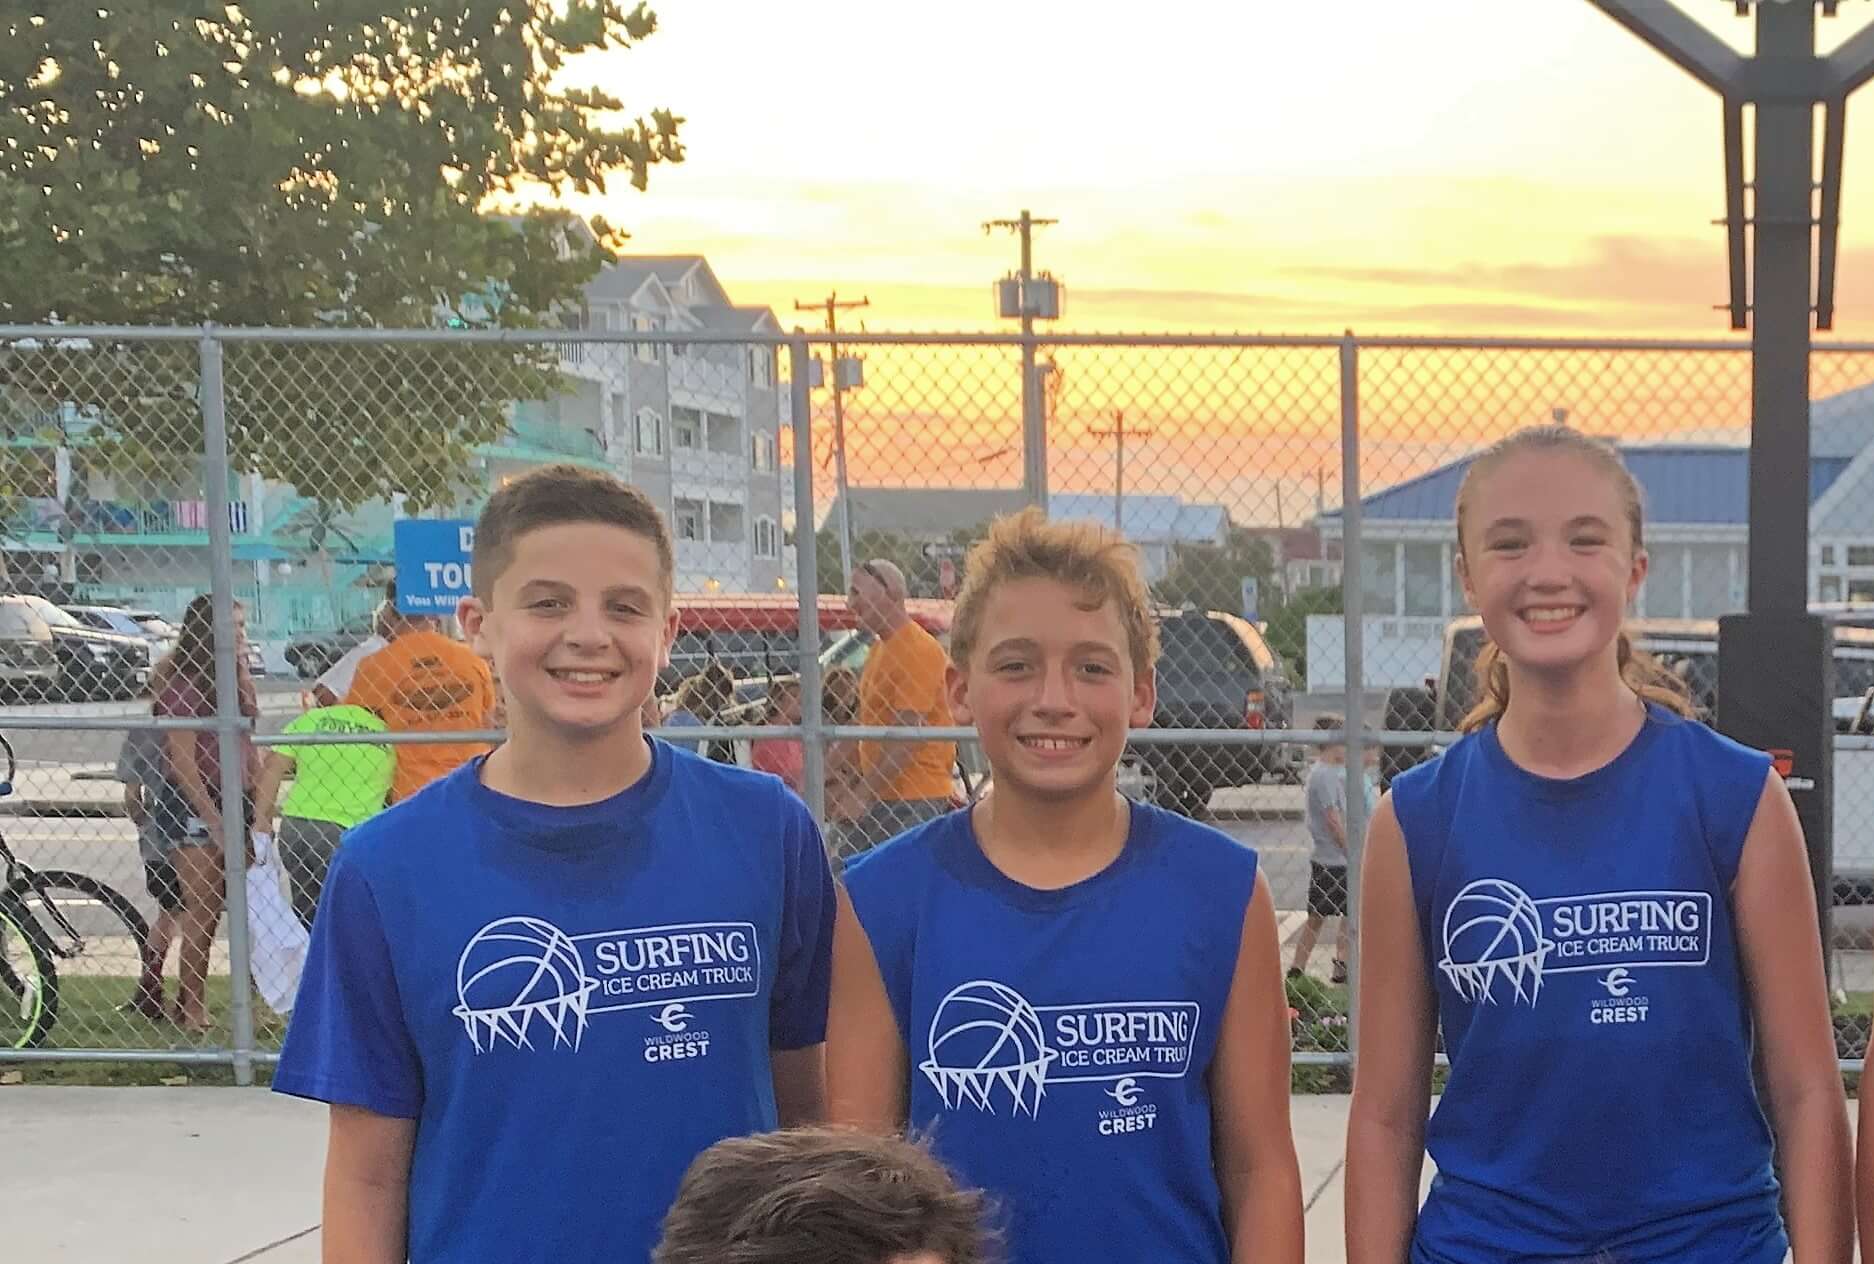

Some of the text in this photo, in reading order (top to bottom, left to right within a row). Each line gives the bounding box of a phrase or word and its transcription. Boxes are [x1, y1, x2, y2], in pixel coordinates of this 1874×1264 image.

[1553, 900, 1699, 938] SURFING
[595, 931, 749, 974] SURFING
[1557, 935, 1699, 957] ICE CREAM TRUCK
[602, 966, 752, 996] ICE CREAM TRUCK
[1591, 996, 1649, 1008] WILDWOOD
[1590, 1006, 1649, 1024] CREST
[643, 1030, 710, 1047] WILDWOOD
[1056, 1010, 1188, 1046] SURFING
[644, 1040, 710, 1062] CREST
[1060, 1049, 1090, 1067] ICE
[1093, 1046, 1150, 1066] CREAM
[1098, 1103, 1157, 1120] WILDWOOD
[1099, 1112, 1157, 1135] CREST
